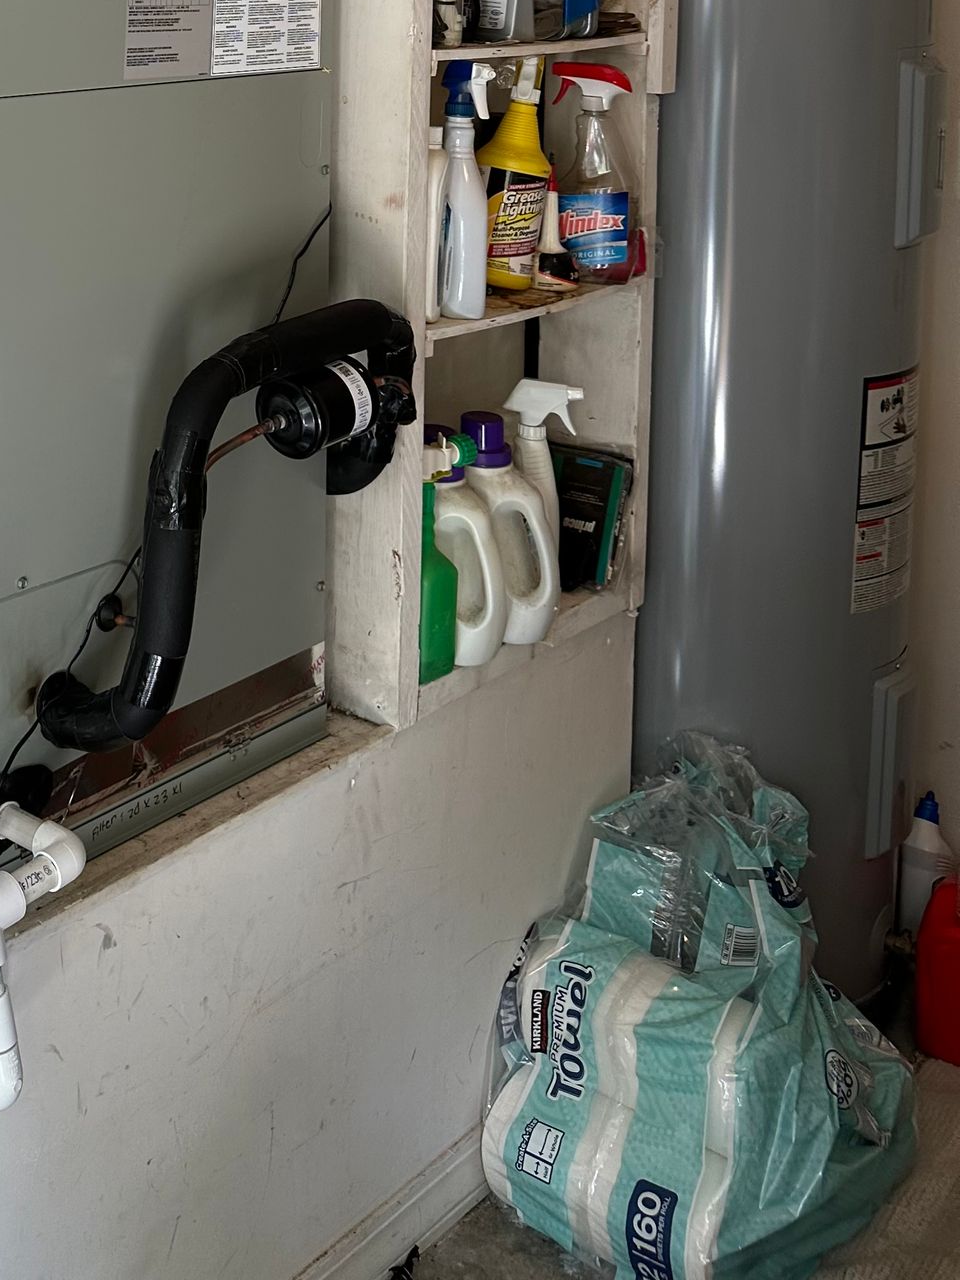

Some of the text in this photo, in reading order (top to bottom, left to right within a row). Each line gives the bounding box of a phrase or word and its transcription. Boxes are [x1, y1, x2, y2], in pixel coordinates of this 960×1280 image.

[498, 200, 545, 220] Lightn
[571, 249, 616, 258] ORIGINAL
[153, 789, 169, 805] 23
[532, 991, 543, 1050] KIRKLAND
[549, 964, 594, 1100] Towel
[550, 989, 568, 1063] PREMIUM
[632, 1191, 662, 1254] 160
[656, 1234, 664, 1261] SHEETS
[660, 1195, 671, 1215] ROLL
